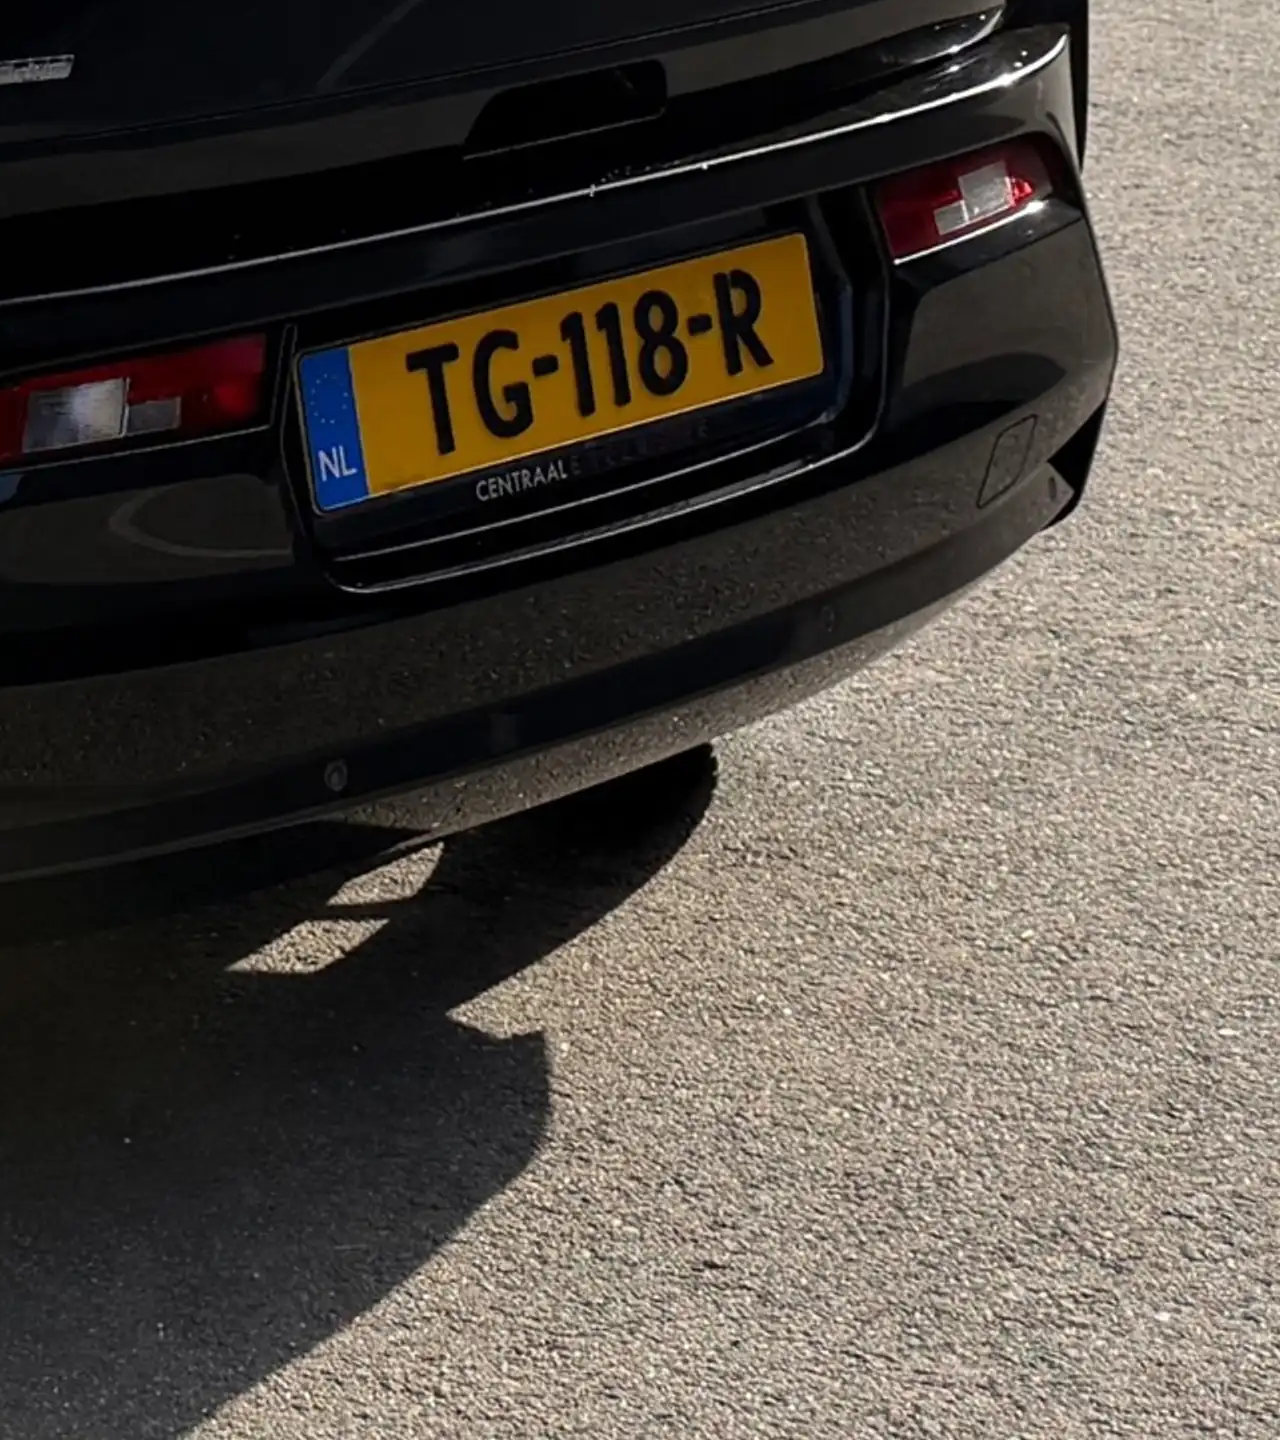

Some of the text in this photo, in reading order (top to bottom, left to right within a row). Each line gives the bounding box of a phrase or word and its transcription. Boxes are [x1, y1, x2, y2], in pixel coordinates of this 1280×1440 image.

[405, 268, 775, 457] TG-118-R
[317, 444, 358, 482] NL
[475, 459, 568, 502] CENTRAAL
